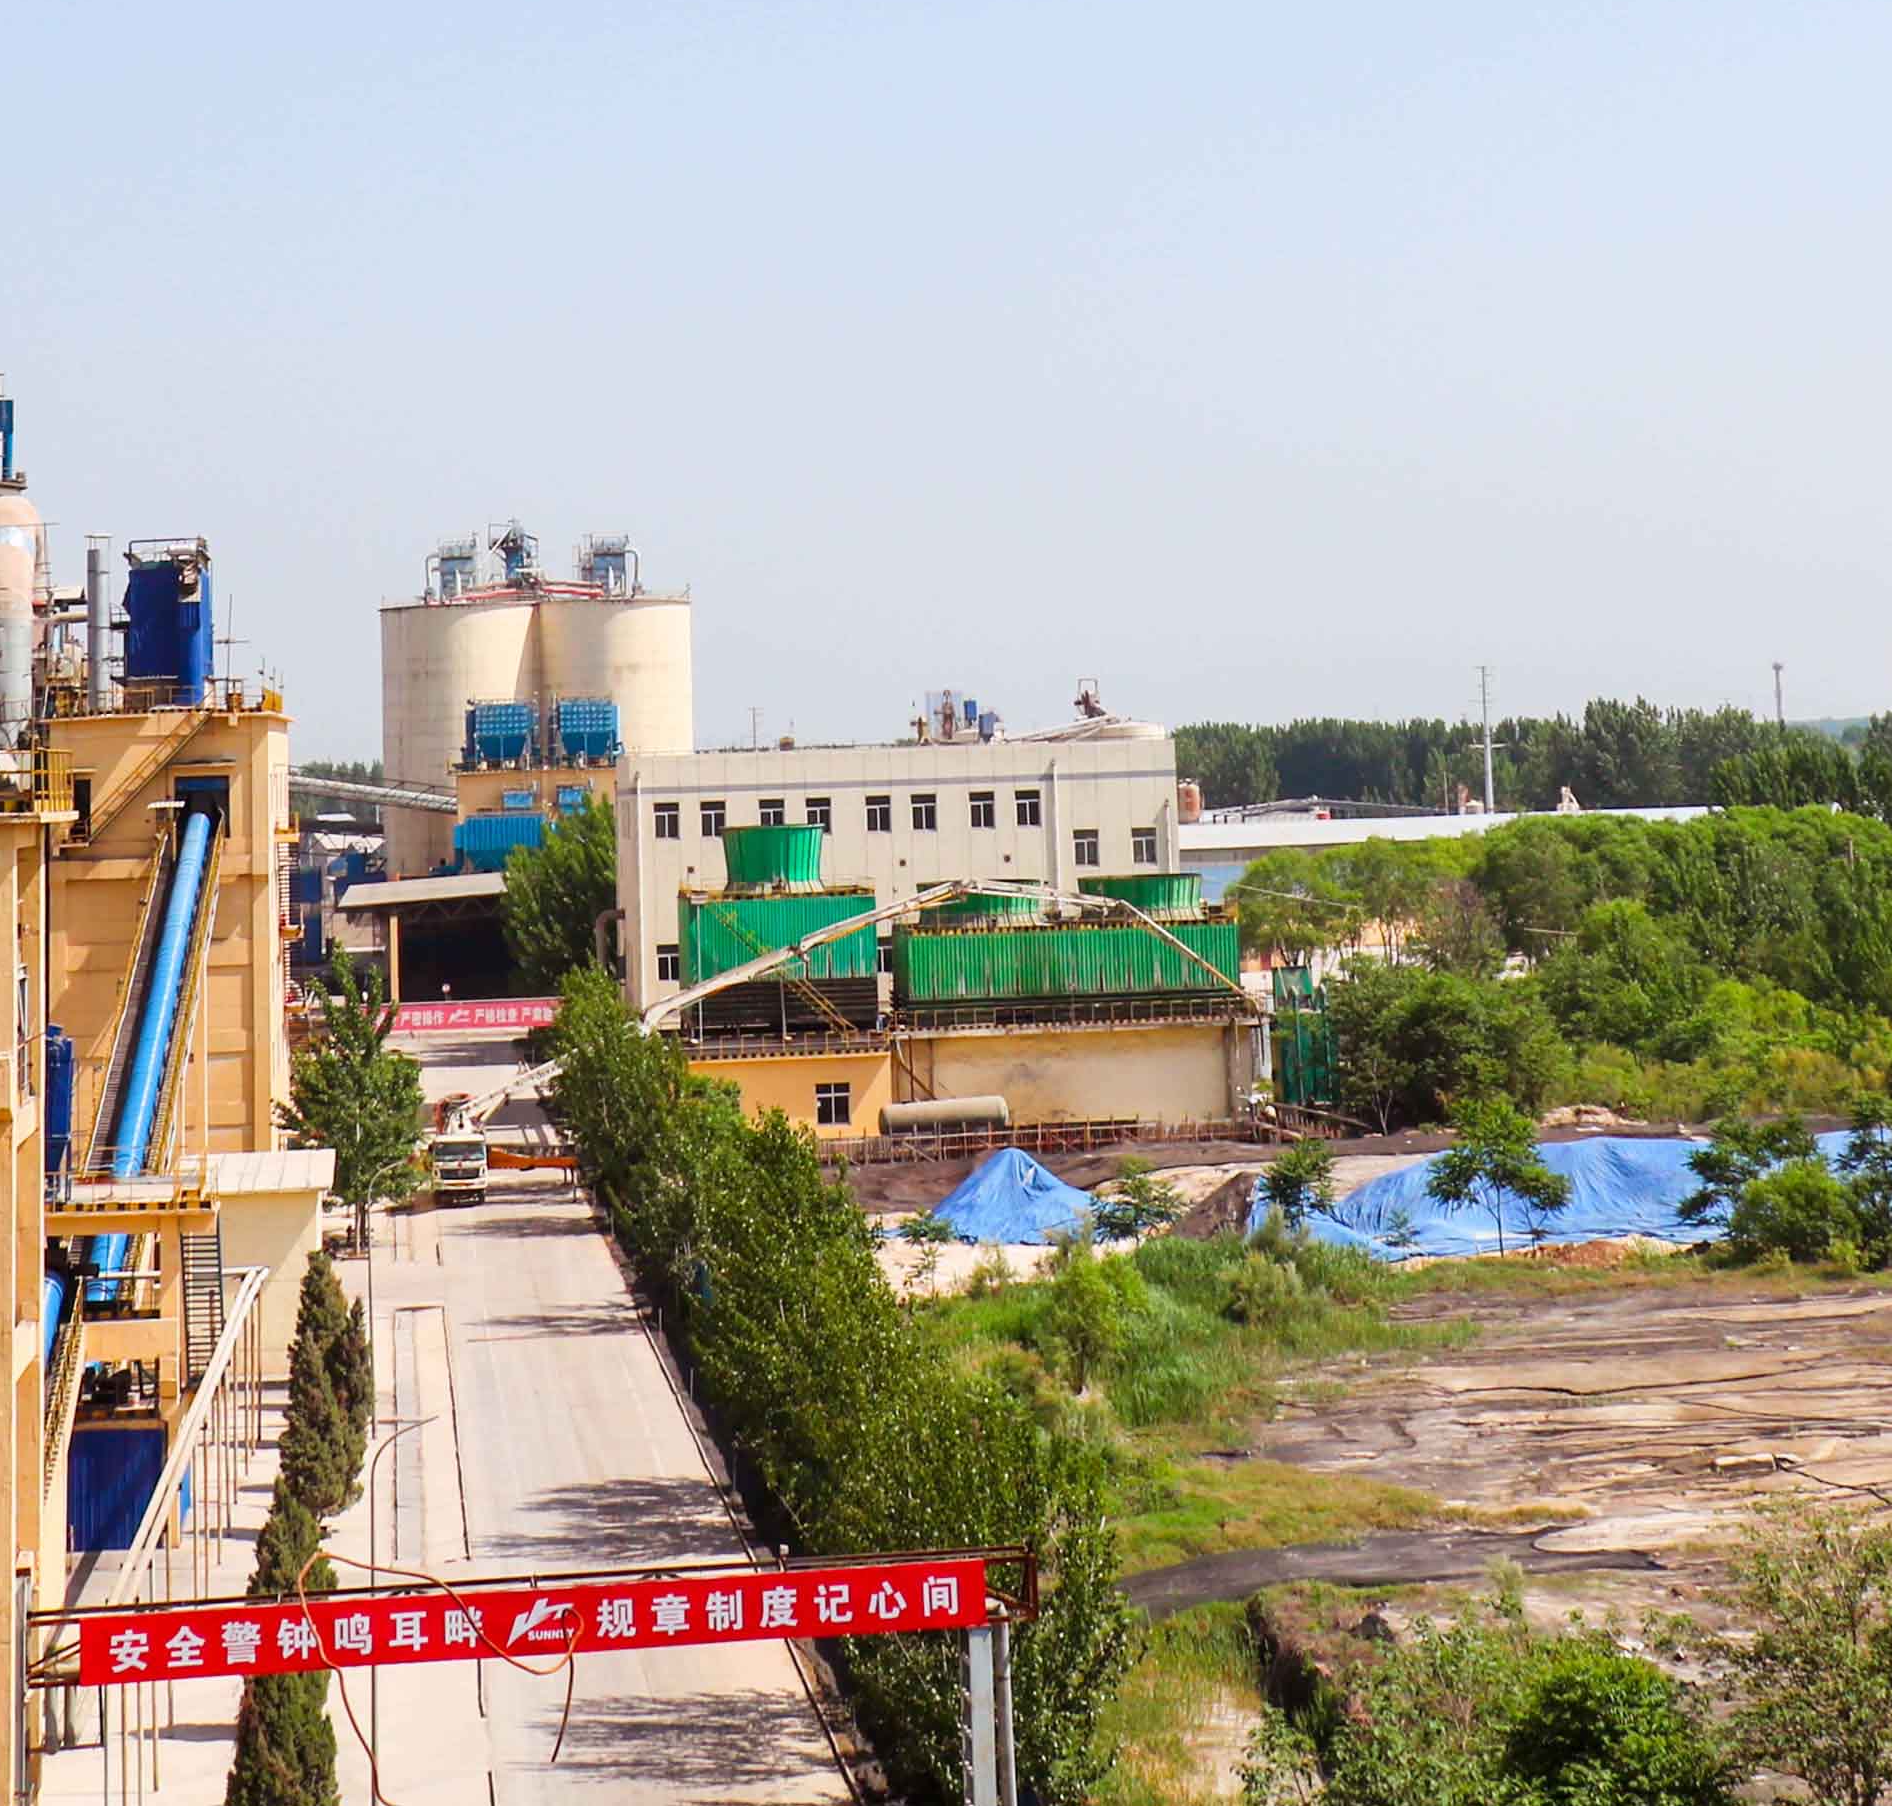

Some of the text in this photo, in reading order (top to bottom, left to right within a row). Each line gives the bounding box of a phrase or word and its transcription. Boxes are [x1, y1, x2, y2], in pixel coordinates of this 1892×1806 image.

[109, 1605, 486, 1673] 安全警钟鸣耳畔
[596, 1575, 960, 1638] 规章制度记心间
